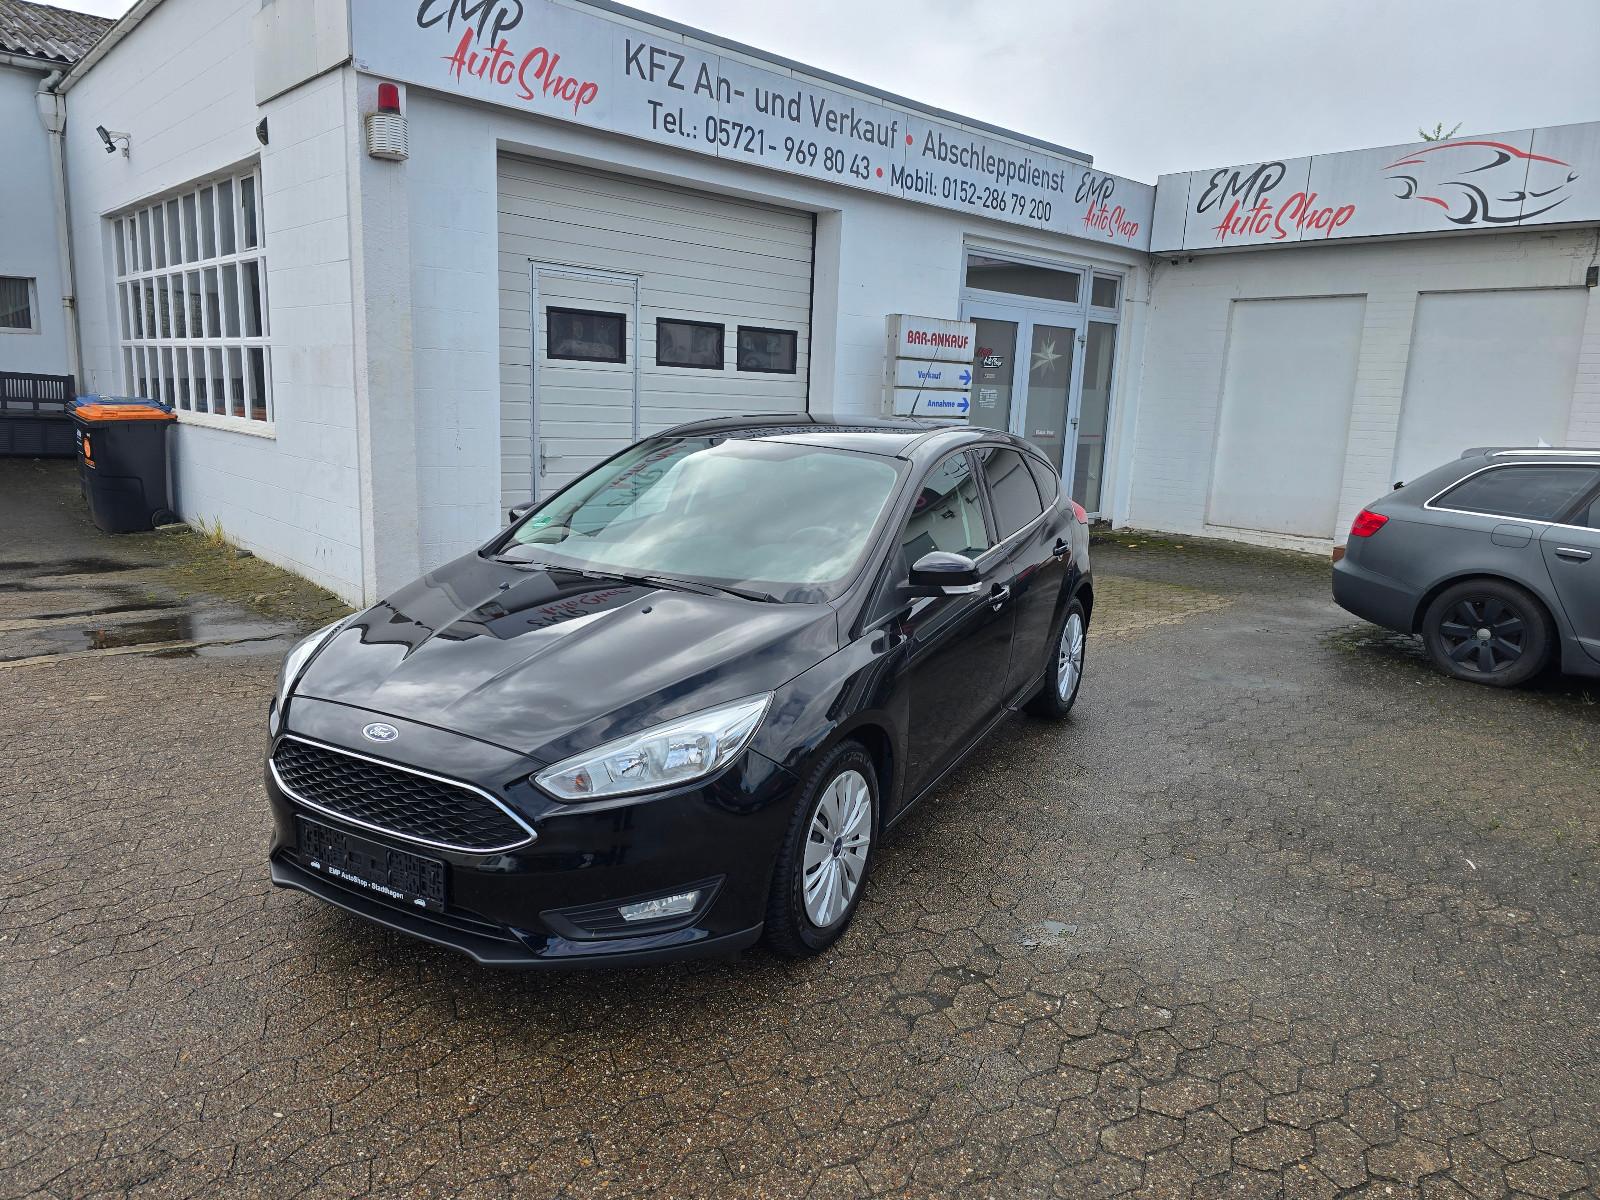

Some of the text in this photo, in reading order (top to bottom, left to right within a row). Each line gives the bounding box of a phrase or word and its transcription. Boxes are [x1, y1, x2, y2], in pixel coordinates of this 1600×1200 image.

[625, 38, 1065, 193] KFZ An- und Verkauf Abschleppdienst
[647, 99, 697, 139] Tel.:
[784, 136, 818, 167] 969
[823, 146, 845, 174] 80
[850, 154, 870, 180] 43
[890, 163, 937, 197] Mobil:
[942, 176, 1007, 212] 0152-286
[1011, 192, 1026, 216] 79
[1029, 198, 1052, 222] 200
[1075, 171, 1115, 207] EMP
[1197, 161, 1286, 214] EMP
[907, 330, 969, 349] BAR-ANKAUF
[918, 370, 942, 380] Verkauf
[927, 399, 956, 408] Annahme
[369, 726, 392, 738] Ford
[328, 866, 341, 876] EMP
